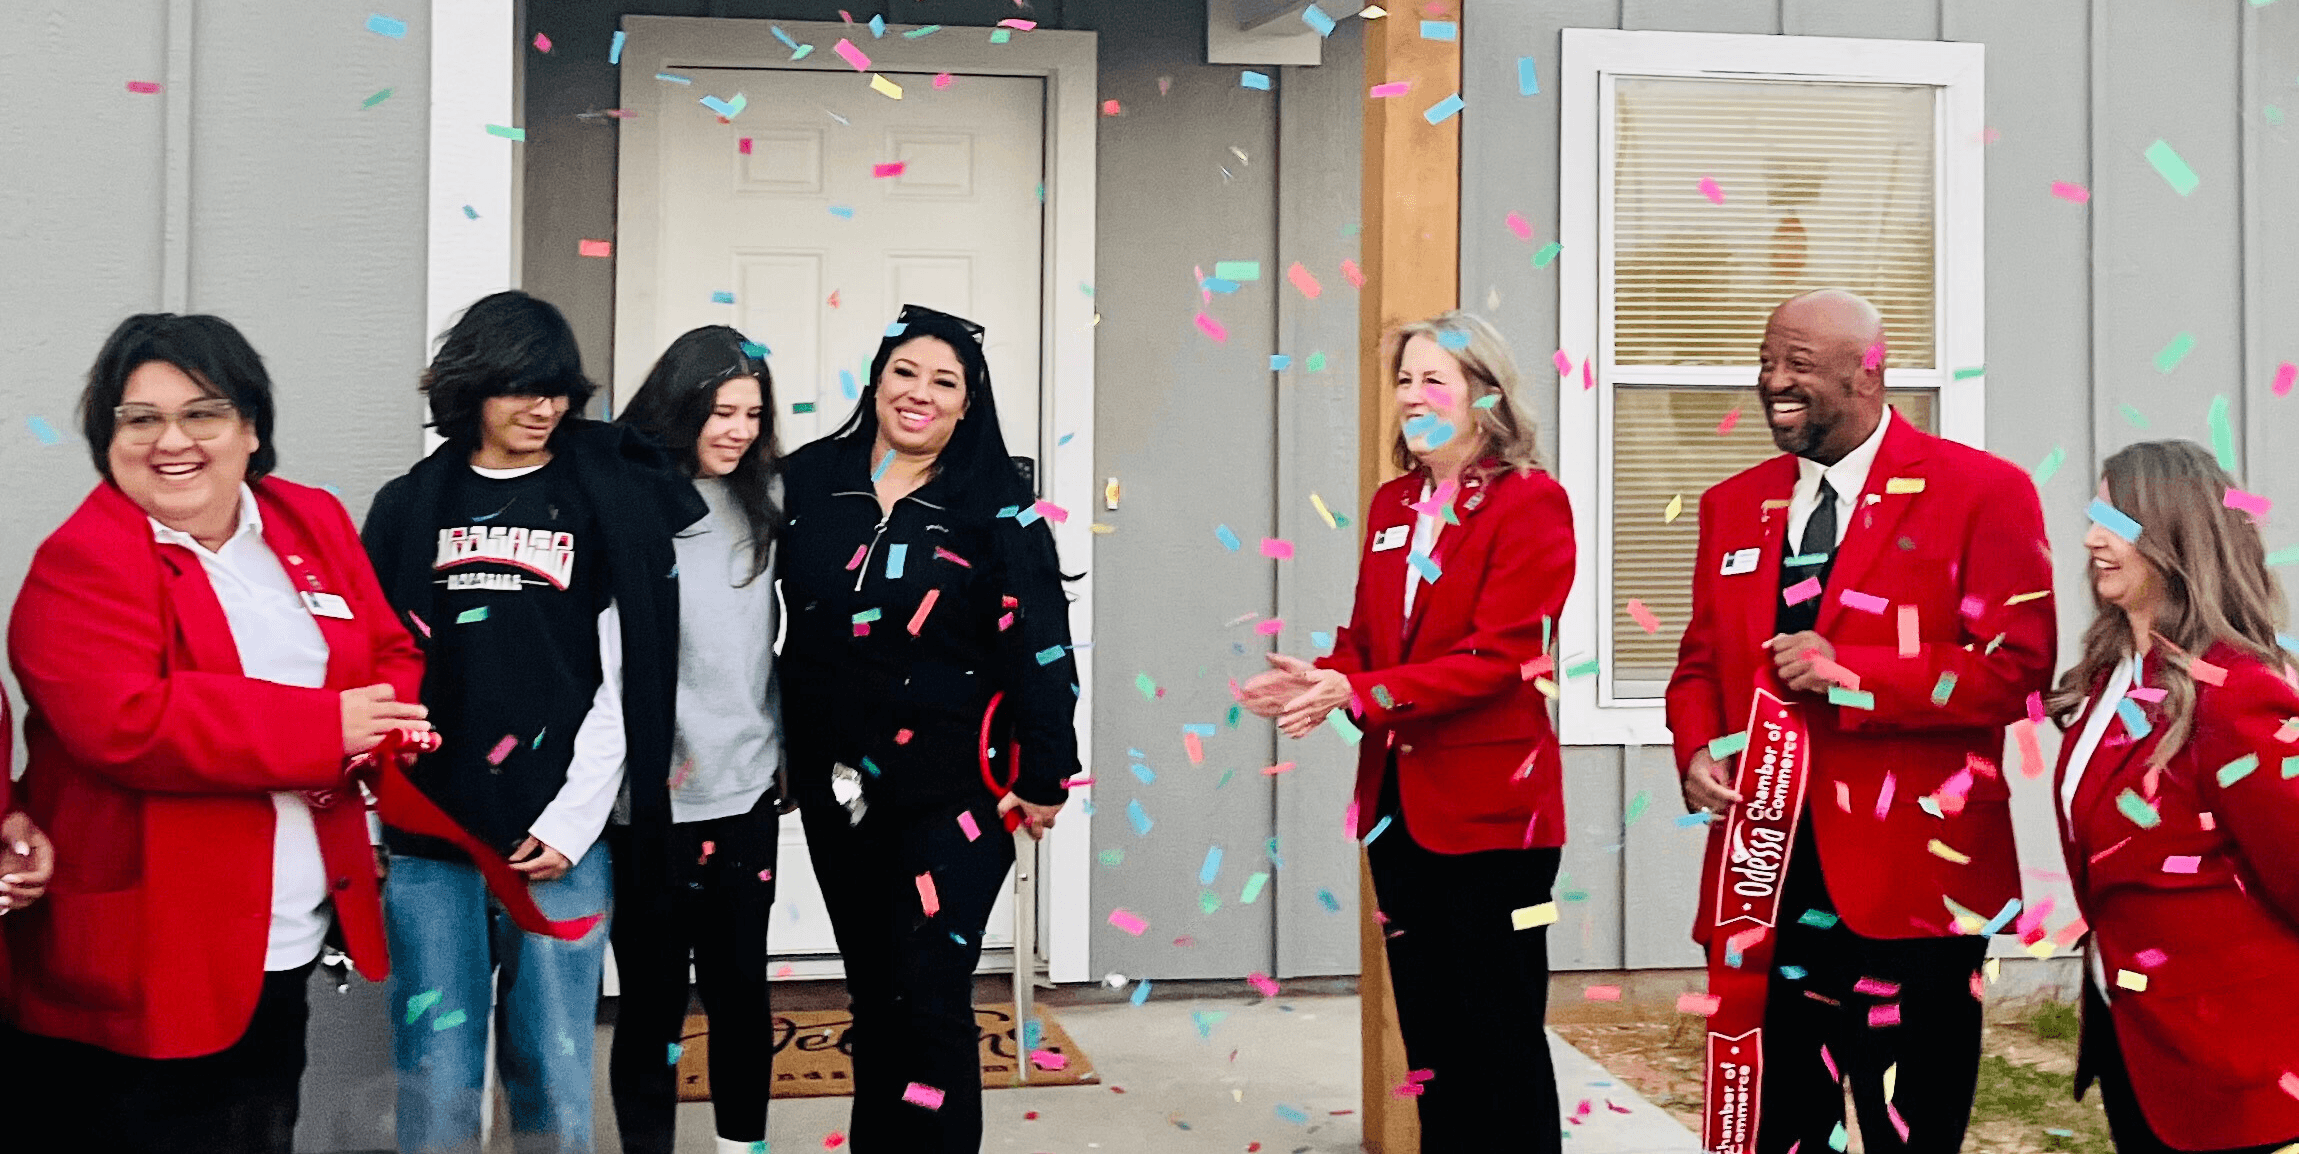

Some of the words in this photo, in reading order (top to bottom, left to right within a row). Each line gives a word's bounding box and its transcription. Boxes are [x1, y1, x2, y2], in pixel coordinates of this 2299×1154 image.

[1746, 745, 1778, 821] Chamber
[1763, 720, 1782, 742] of
[1765, 731, 1798, 821] Commerce
[1731, 827, 1786, 897] Odessa
[1719, 1062, 1736, 1080] of
